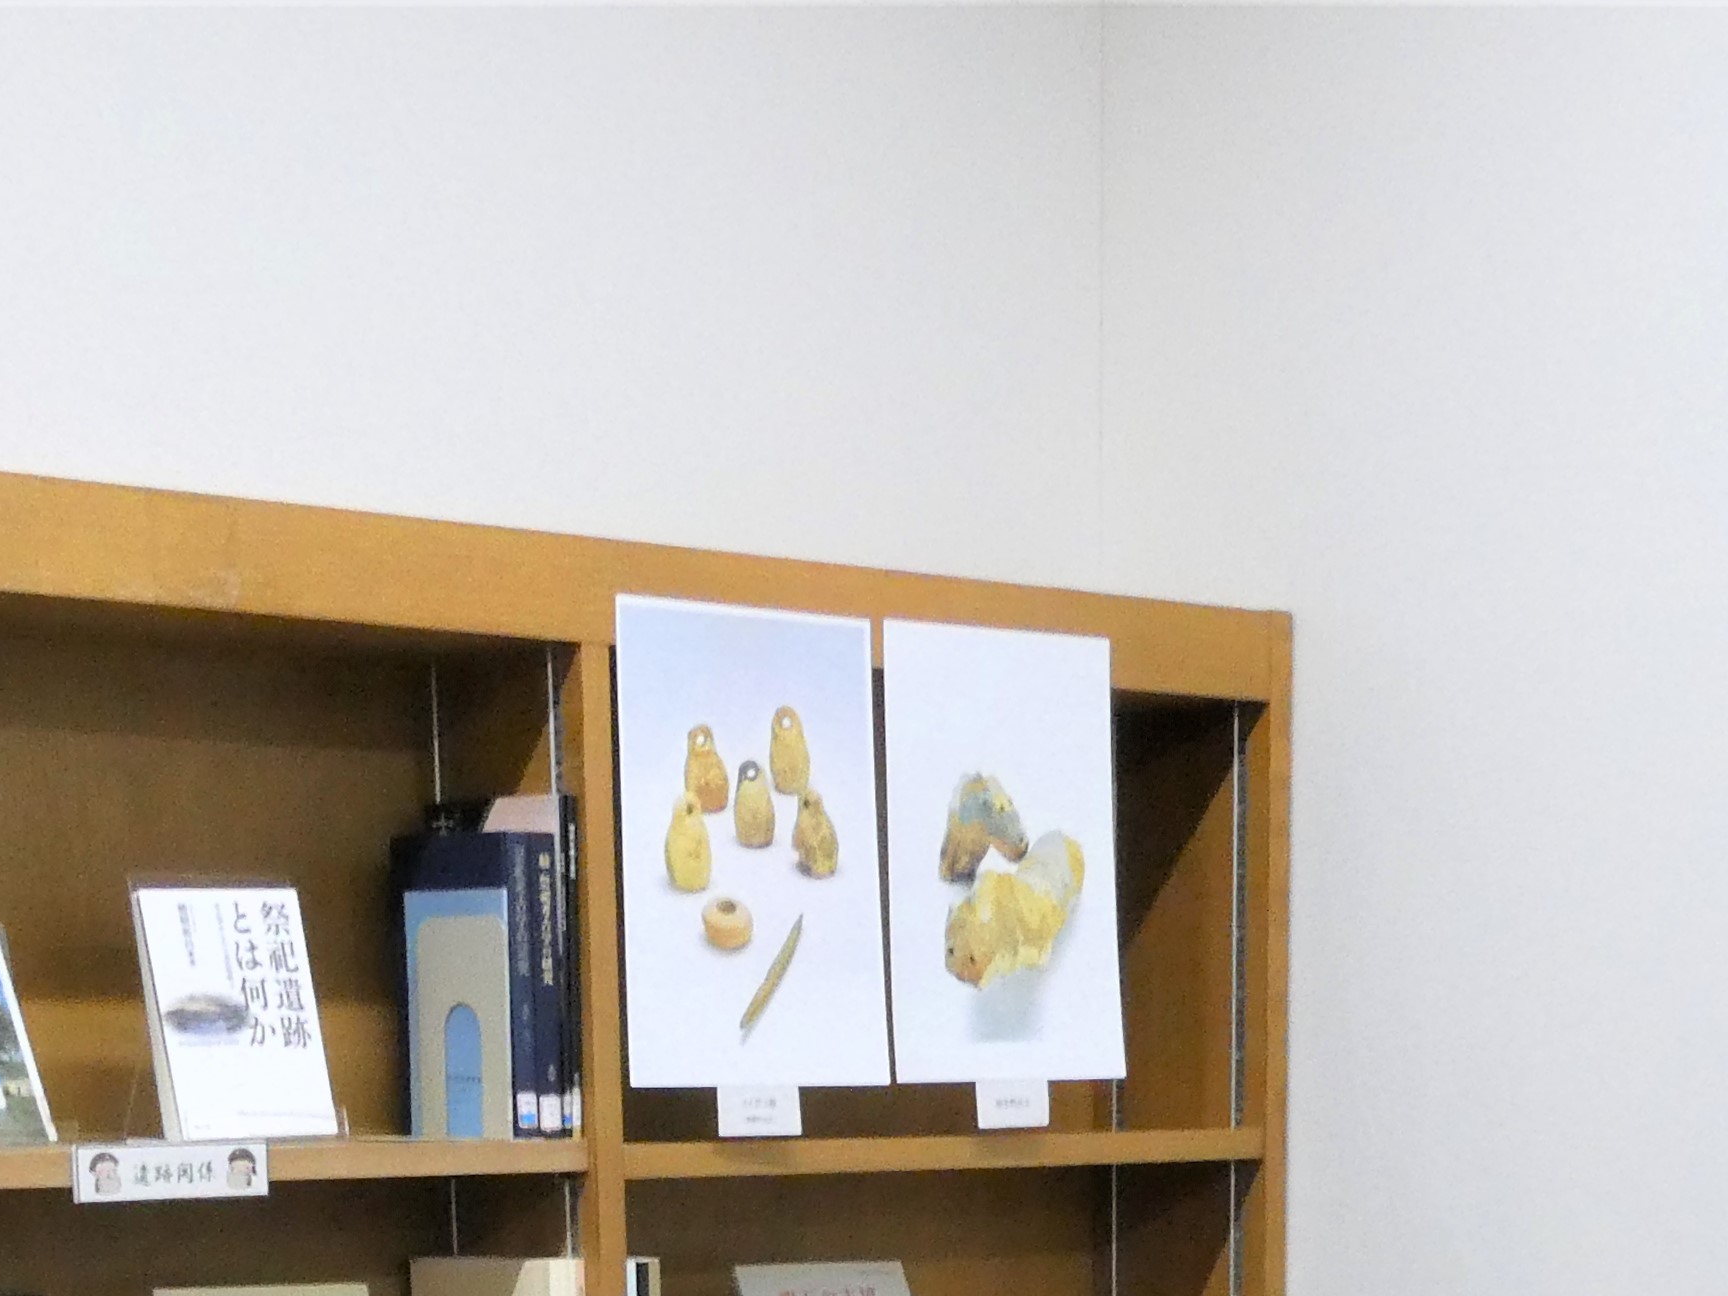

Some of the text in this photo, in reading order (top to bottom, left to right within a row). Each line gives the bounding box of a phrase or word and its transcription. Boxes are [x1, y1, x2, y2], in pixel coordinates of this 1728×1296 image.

[233, 901, 276, 1048] とは何か
[260, 901, 313, 1050] 祭祀遺跡
